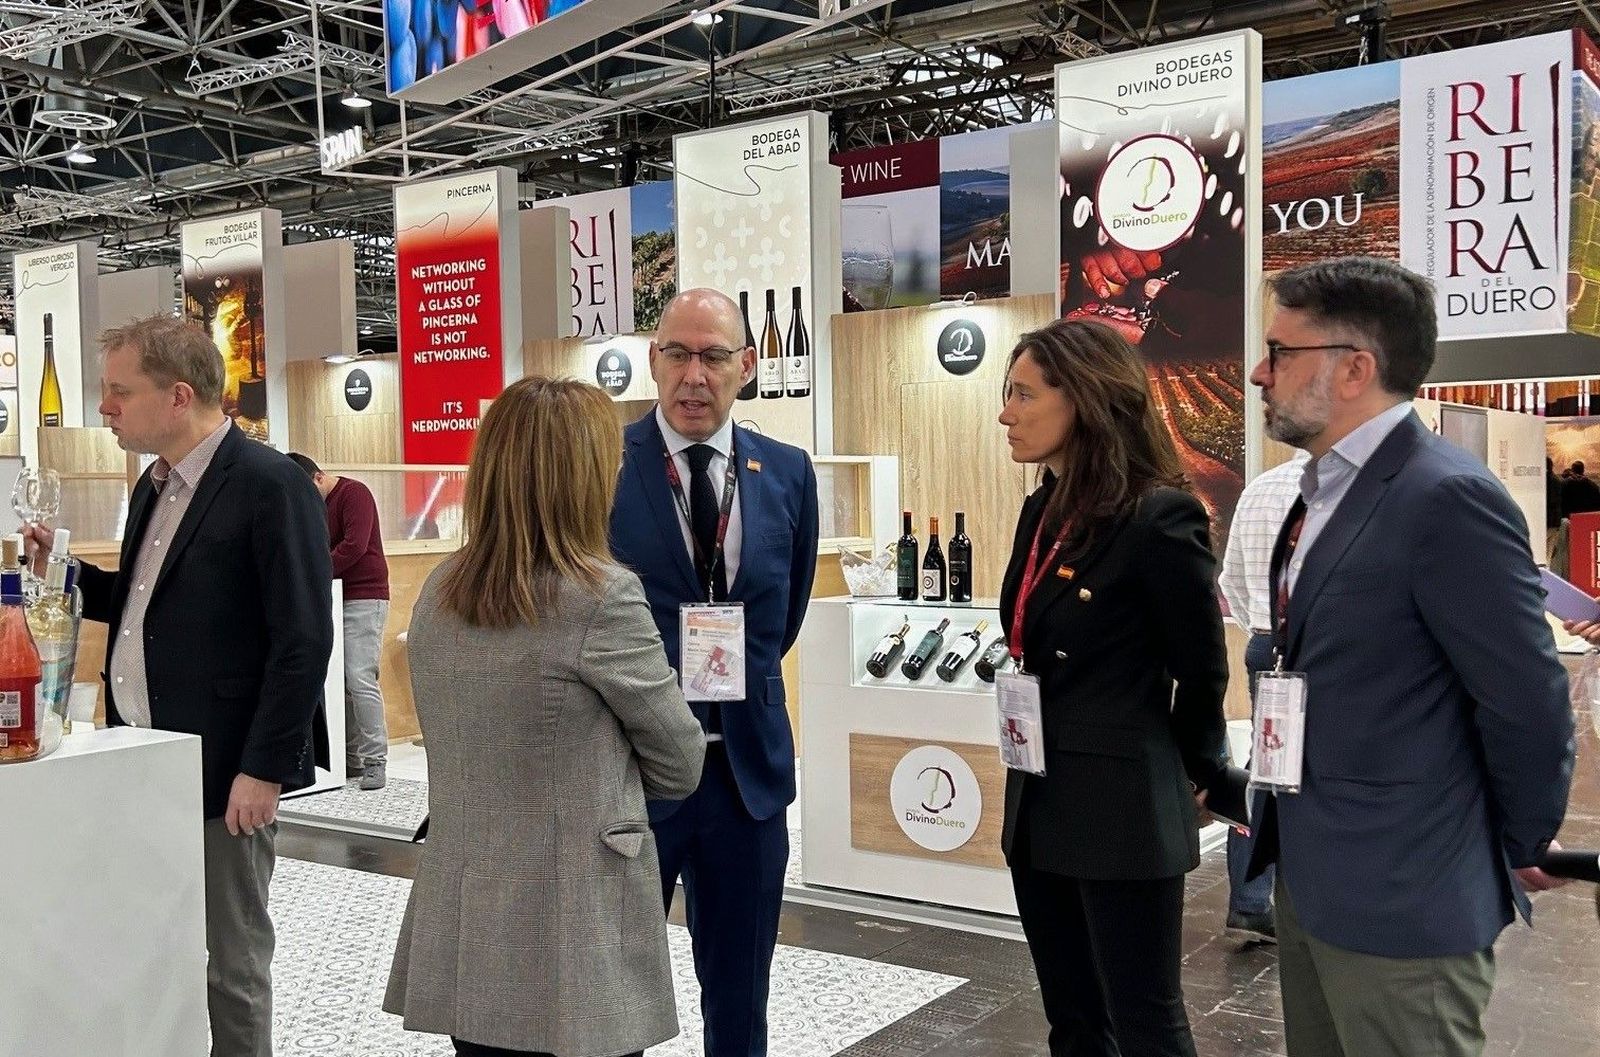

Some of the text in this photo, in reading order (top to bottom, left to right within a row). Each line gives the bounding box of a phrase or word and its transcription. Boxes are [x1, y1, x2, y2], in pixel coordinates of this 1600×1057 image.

[1156, 50, 1233, 75] BODEGAS
[1117, 66, 1233, 98] DIVINO DUERO
[1446, 72, 1528, 143] RI
[320, 125, 364, 168] SPAIN
[752, 128, 800, 146] BODEGA
[743, 141, 800, 160] DEL ABAD
[851, 157, 902, 184] WINE
[1445, 142, 1534, 211] BE
[447, 183, 491, 199] PINCERNA
[1113, 212, 1188, 229] DivinoDuero
[1268, 192, 1365, 234] YOU
[224, 220, 258, 234] BODEGAS
[205, 231, 258, 246] FRUTOS VILLAR
[1445, 213, 1549, 278] RA
[50, 261, 75, 272] VERDEJO
[411, 258, 487, 279] NETWORKING
[423, 277, 476, 295] WITHOUT
[1481, 277, 1514, 288] DEL
[419, 294, 482, 313] A GLASS OF
[1447, 286, 1556, 317] DUERO
[422, 313, 479, 330] PINCERNA
[431, 330, 468, 346] IS NOT
[413, 346, 491, 365] NETWORKING.
[443, 401, 463, 414] IT'S
[906, 811, 966, 829] DivinoDuero
